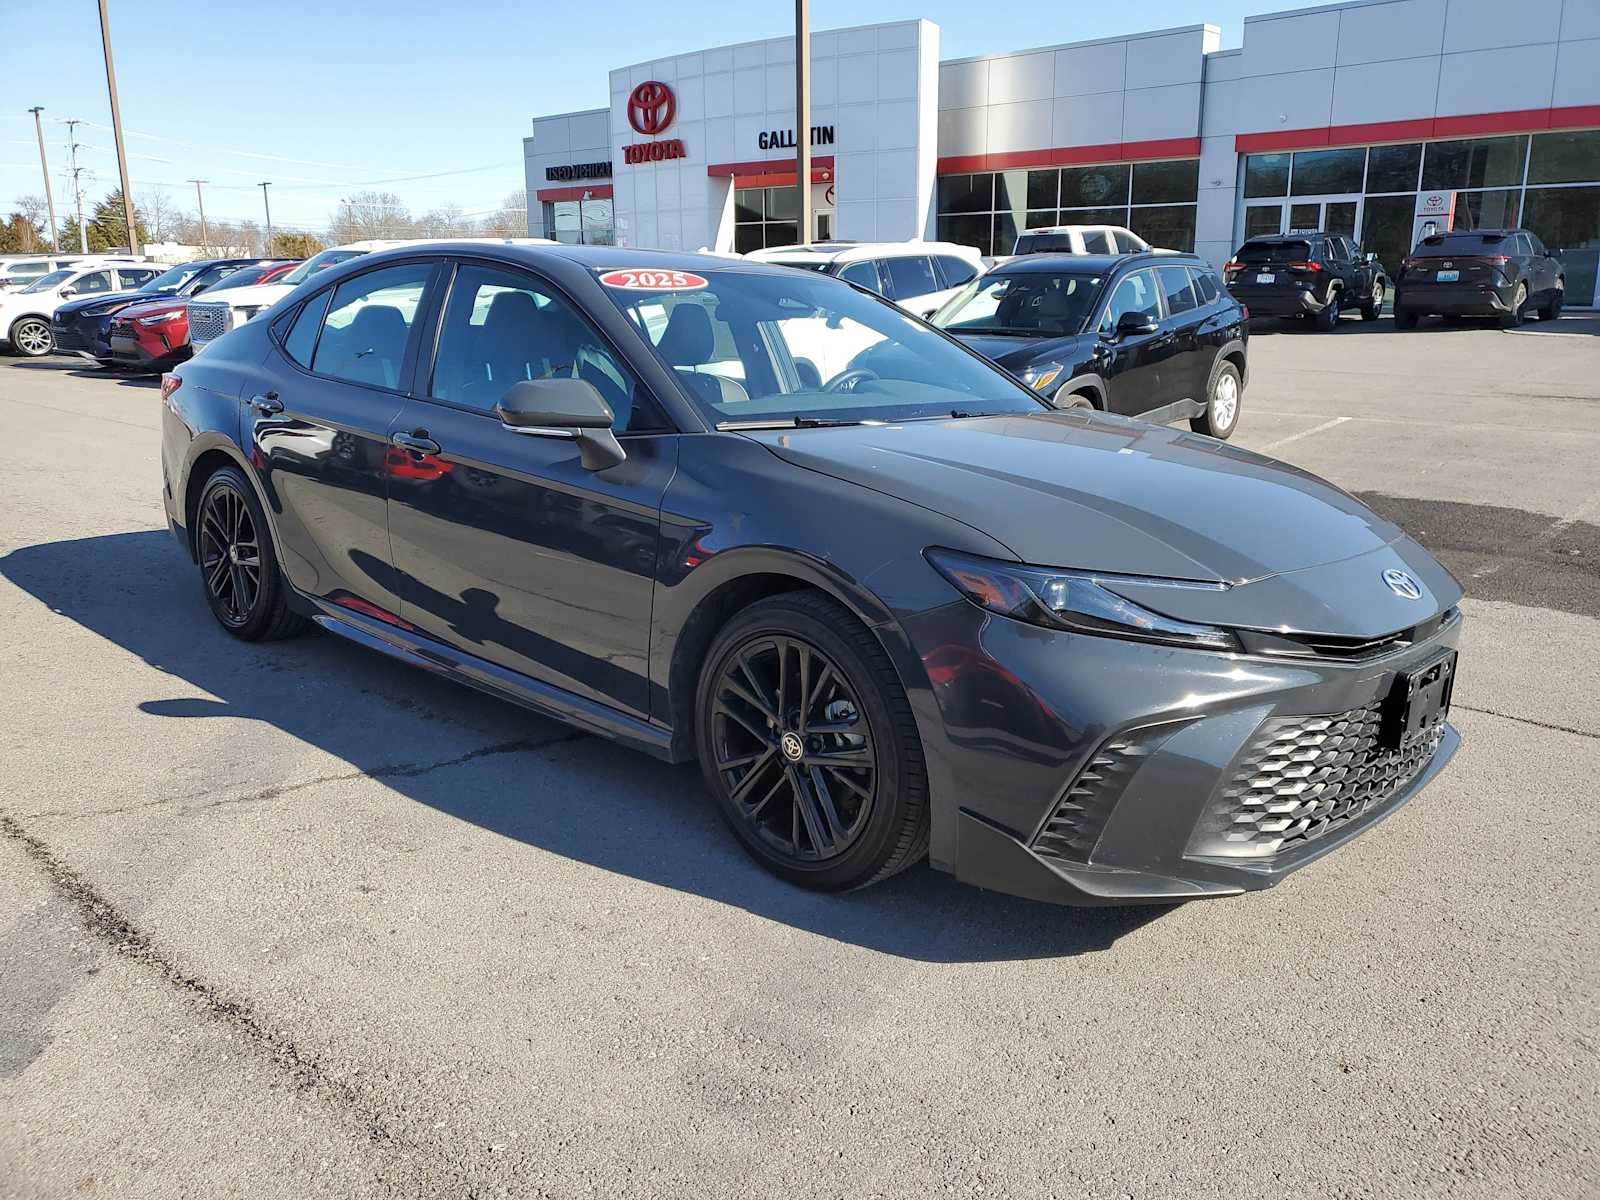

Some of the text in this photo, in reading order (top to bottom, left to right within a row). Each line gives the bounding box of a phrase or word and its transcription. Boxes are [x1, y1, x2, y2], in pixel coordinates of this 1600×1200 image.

[759, 126, 834, 149] GALLTIN
[622, 139, 687, 164] TOYOTA
[546, 166, 572, 181] USED
[621, 272, 688, 287] 2025
